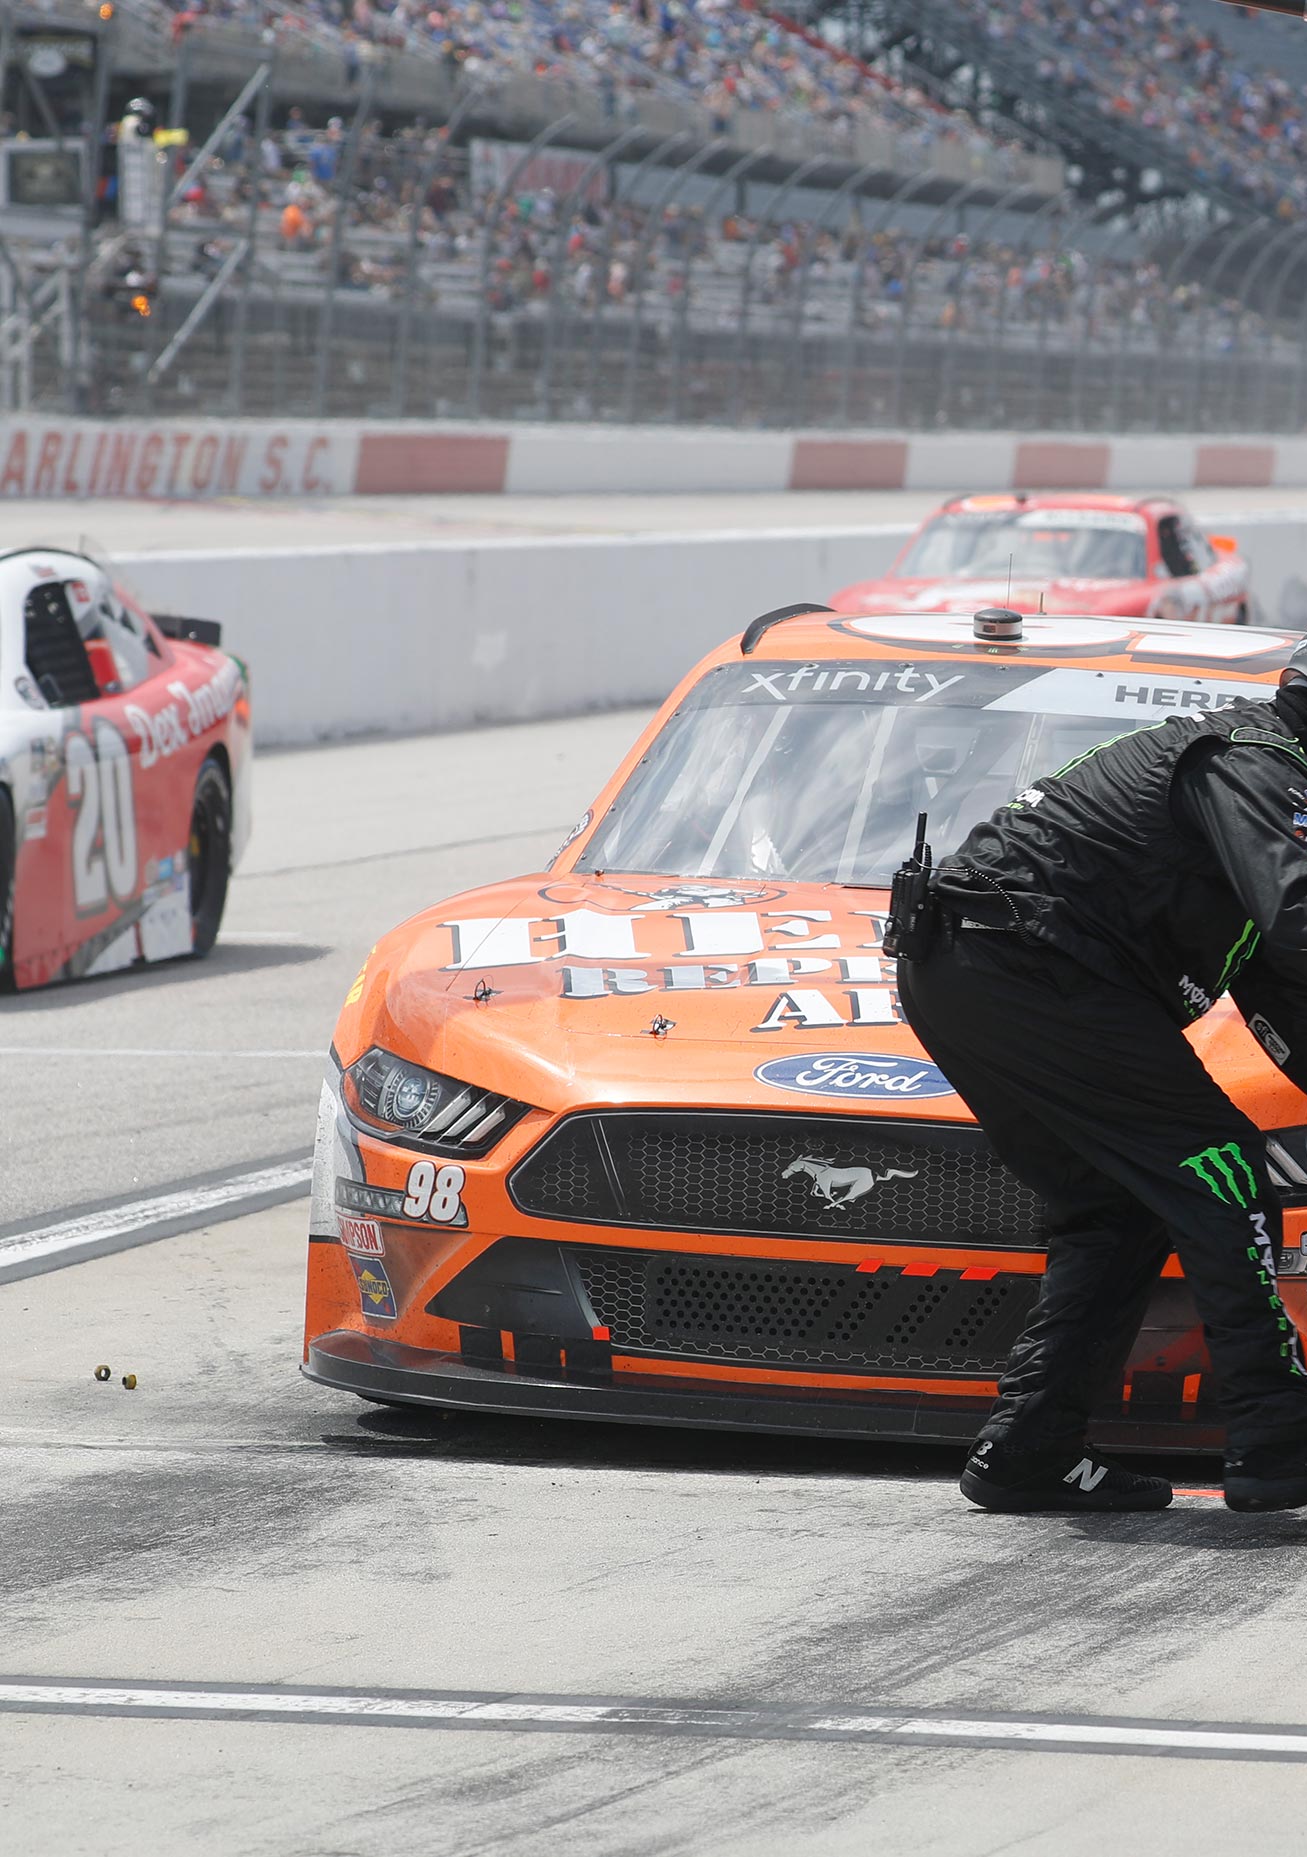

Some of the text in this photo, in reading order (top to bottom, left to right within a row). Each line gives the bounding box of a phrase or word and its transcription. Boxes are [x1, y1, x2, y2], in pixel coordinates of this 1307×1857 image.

[1, 430, 248, 494] ARLINGTON
[742, 663, 966, 701] xfinity
[1115, 685, 1272, 710] HER
[123, 704, 188, 769] Dex
[66, 724, 138, 907] 20
[795, 1057, 930, 1095] Ford
[403, 1161, 465, 1222] 98
[359, 1277, 389, 1296] SUNOCO
[1062, 1457, 1109, 1492] N
